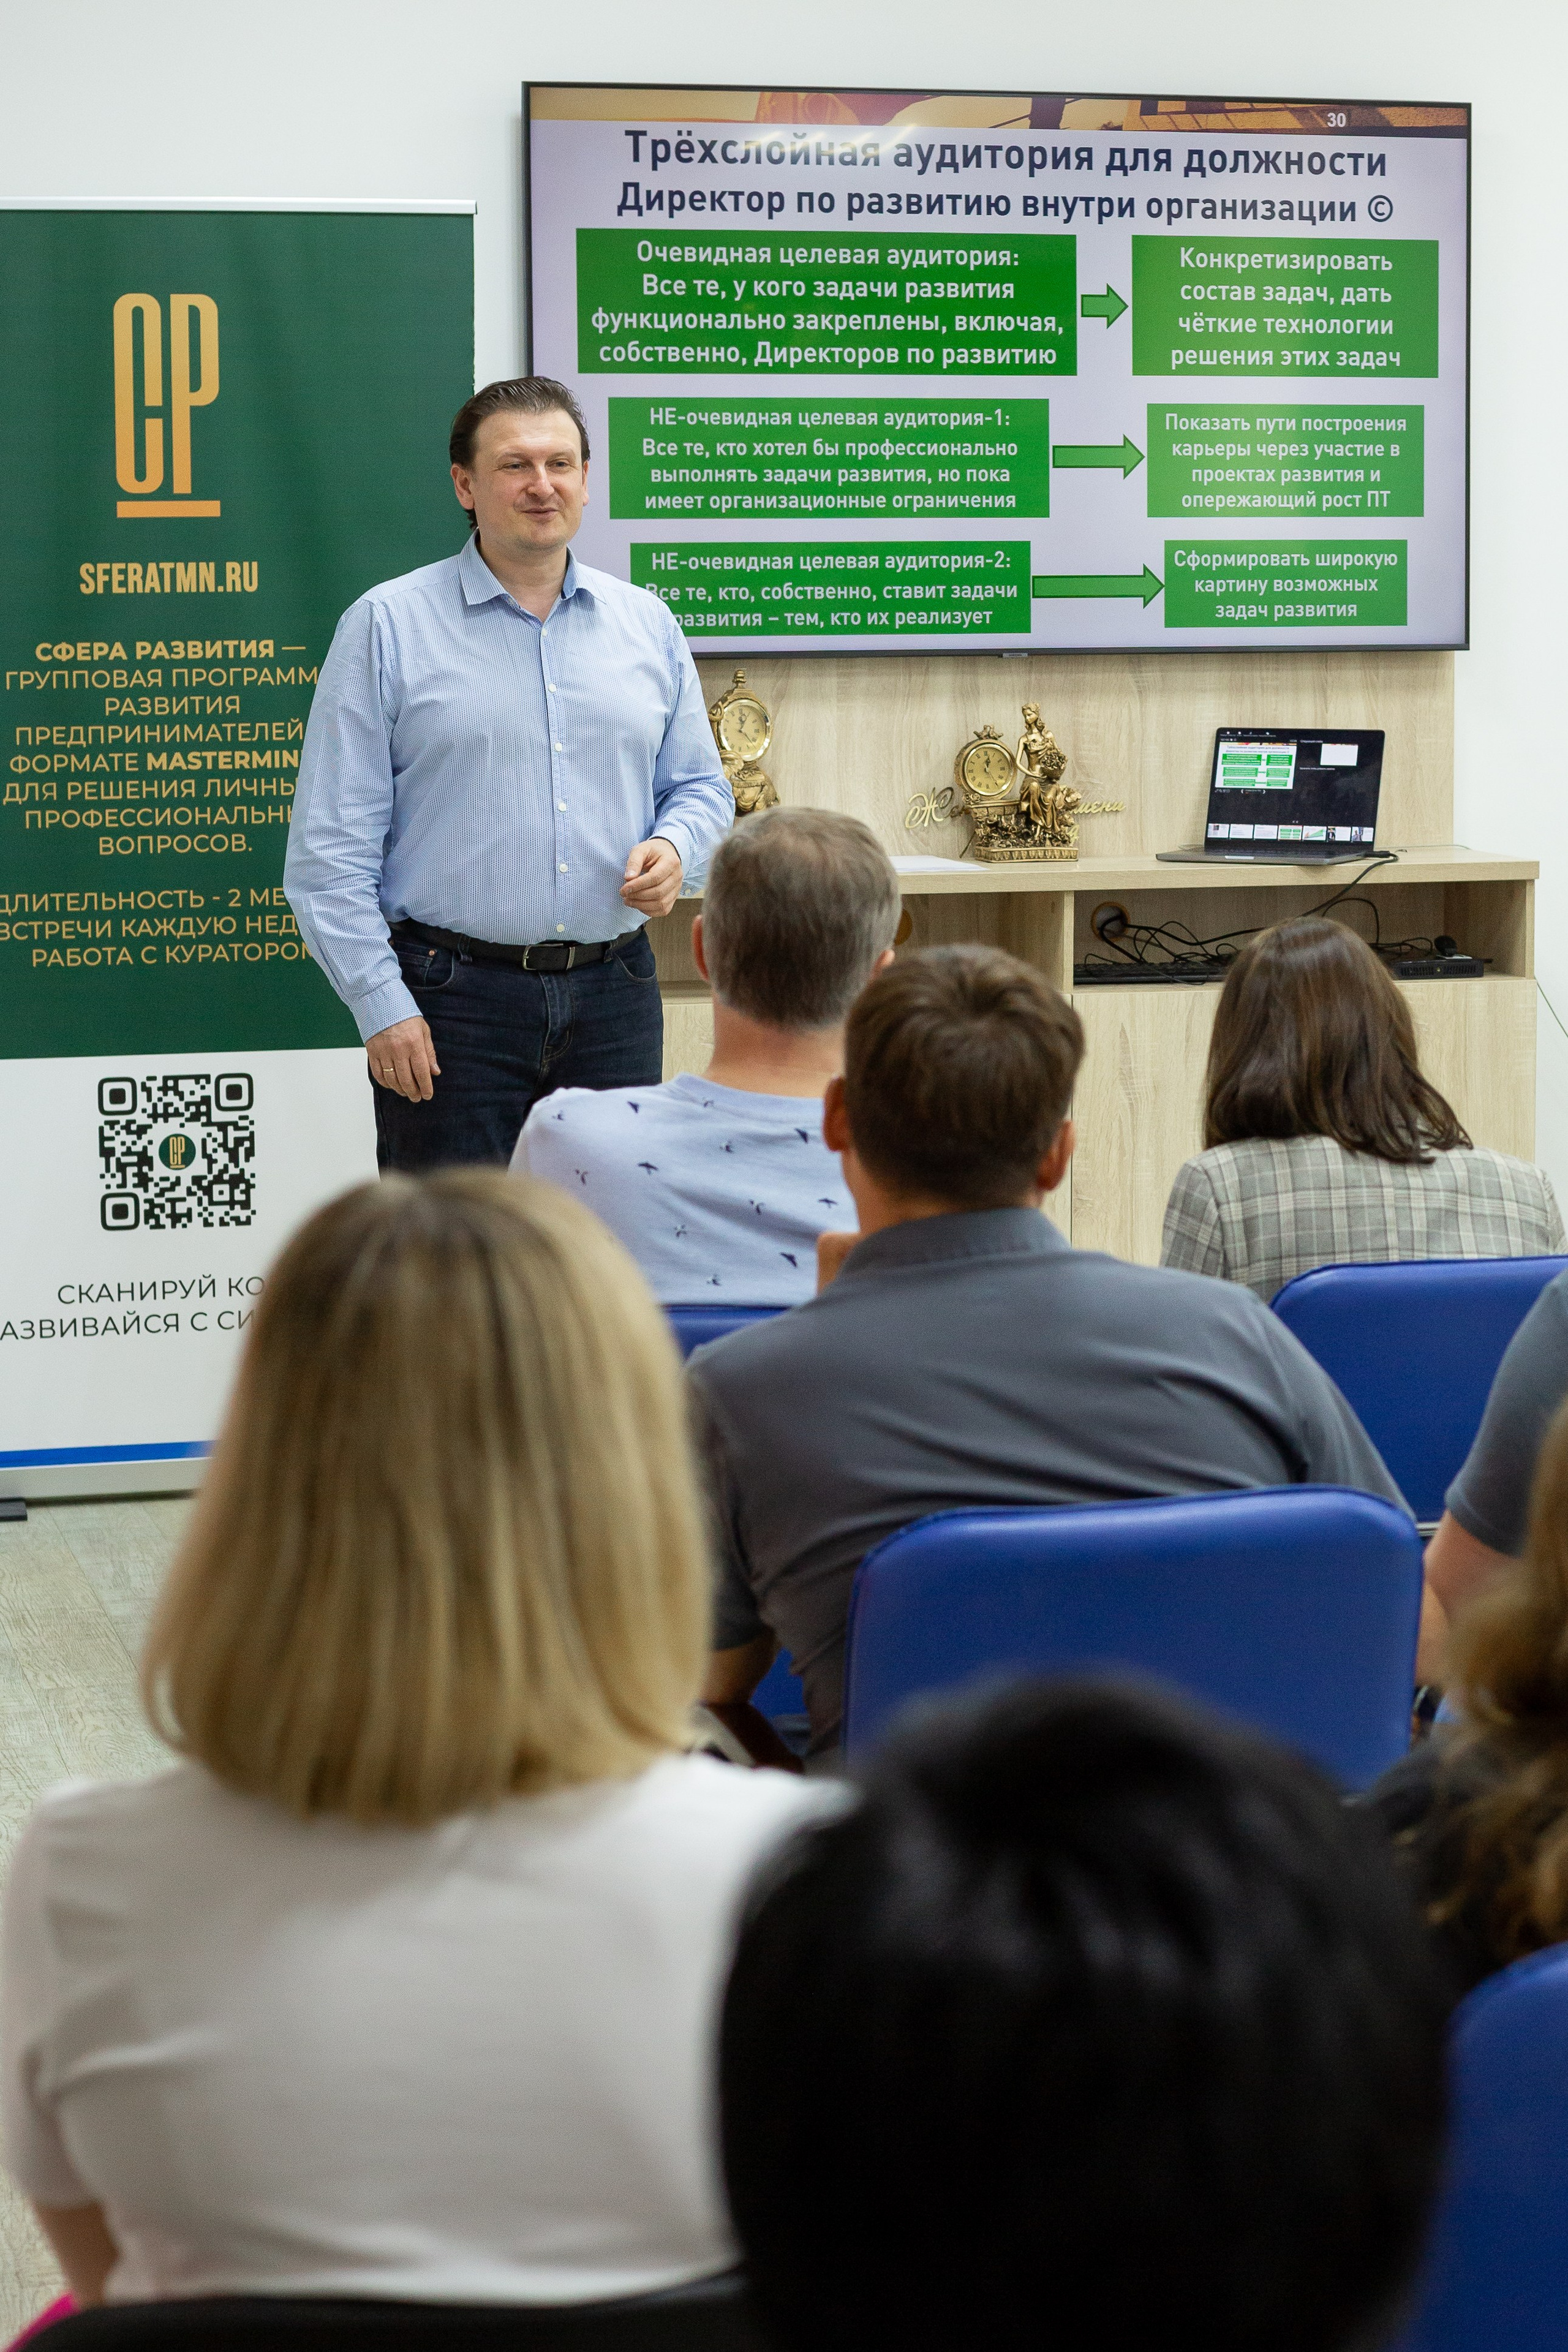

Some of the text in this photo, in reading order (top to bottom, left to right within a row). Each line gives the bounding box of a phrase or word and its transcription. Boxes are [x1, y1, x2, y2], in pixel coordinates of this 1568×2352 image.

[1327, 113, 1346, 127] 30
[625, 130, 1385, 178] Трёхслойная аудитория для должности
[617, 182, 784, 219] Директор
[797, 192, 834, 213] по
[848, 193, 1011, 221] развитию
[1023, 196, 1134, 224] внутри
[1147, 198, 1355, 225] организации
[638, 241, 1018, 270] Очевидная целевая аудитория:
[1181, 247, 1392, 274] Конкретизировать
[643, 274, 1014, 303] Все те, у кого задачи развития
[1181, 285, 1392, 305] состав задач, дать
[592, 307, 1063, 335] функционально закреплены, включая,
[1179, 312, 1392, 334] чёткие технологии
[600, 341, 1056, 369] собственно, Директоров по развитию
[1172, 350, 1400, 369] решения этих задач
[650, 407, 1009, 429] НЕ-очевидная целевая аудитория-1:
[1166, 413, 1406, 435] Показать пути построения
[643, 438, 1017, 460] Все те, кто хотел бы профессионально
[1173, 443, 1400, 460] карьеры через участие в
[651, 469, 1009, 486] выполнять задачи развития, но пока
[1193, 469, 1380, 486] проектах развития и
[646, 496, 1016, 513] имеет организационные ограничения
[1182, 491, 1390, 511] опережающий рост ПТ
[652, 551, 1010, 573] НЕ-очевидная целевая аудитория-2:
[1175, 550, 1397, 570] Сформировать широкую
[80, 562, 258, 594] SFERATMN.RU
[1195, 579, 1378, 596] картину возможных
[685, 587, 712, 603] те,
[719, 587, 755, 602] кто,
[761, 582, 876, 601] собственно,
[883, 586, 946, 598] ставит
[951, 586, 1017, 601] задачи
[784, 613, 824, 628] тем,
[831, 612, 861, 625] кто
[867, 612, 889, 625] их
[895, 611, 993, 628] реализует
[1216, 605, 1357, 621] задач развития
[36, 642, 127, 661] СФЕРА
[136, 639, 274, 659] РАЗВИТИЯ
[6, 667, 318, 690] ГРУППОВАЯ ПРОГРАММ
[105, 696, 239, 715] РАЗВИТИЯ
[16, 718, 303, 748] ПРЕДПРИНИМАТЕЛЕЙ
[10, 750, 303, 774] ФОРМАТЕ MASTERMIN
[3, 778, 298, 805] ДЛЯ РЕШЕНИЯ ЛИЧНЫ
[26, 805, 292, 829] ПРОФЕССИОНАЛЬН
[99, 834, 252, 855] ВОПРОСОВ.
[228, 889, 241, 907] 2
[250, 888, 285, 906] МЕ
[122, 916, 236, 939] КАЖДУЮ
[246, 914, 298, 937] НЕД
[32, 947, 133, 967] РАБОТА
[141, 946, 157, 964] С
[58, 1274, 265, 1304] СКАНИРУЙ КО
[0, 1310, 255, 1340] АЗВИВАЙСЯ С СИ
